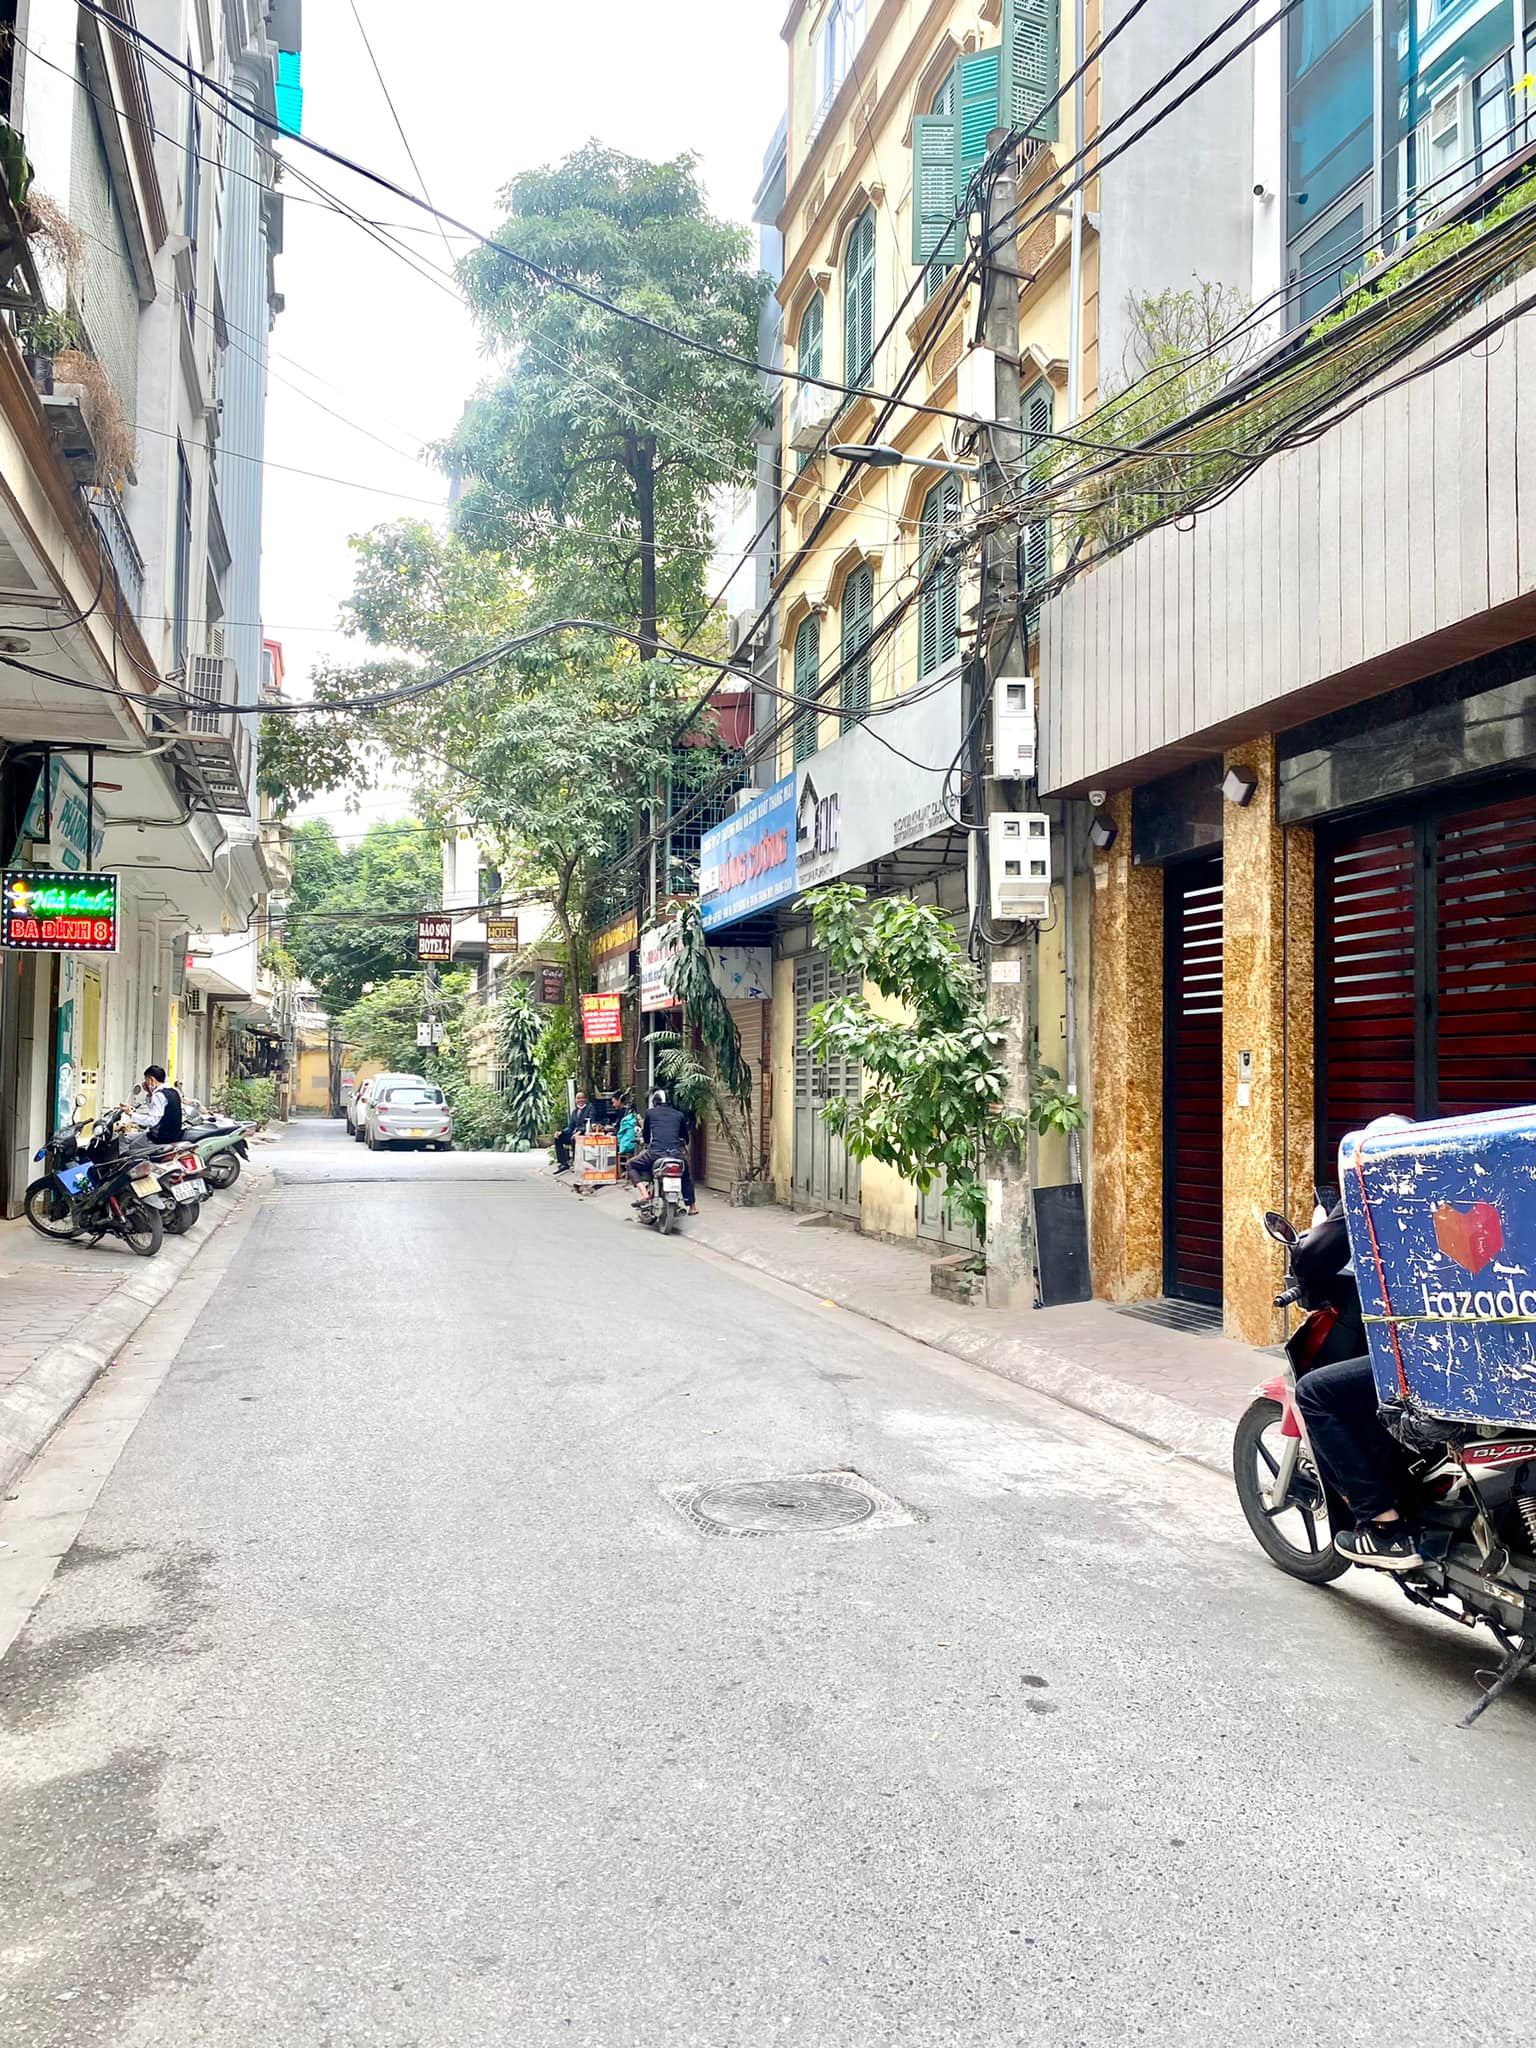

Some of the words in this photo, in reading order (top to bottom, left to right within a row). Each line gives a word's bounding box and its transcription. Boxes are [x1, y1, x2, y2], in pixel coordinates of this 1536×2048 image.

[11, 919, 39, 939] BA
[94, 921, 108, 941] 8
[487, 927, 517, 938] HOTEL
[418, 938, 444, 953] HOTEL
[1472, 1445, 1536, 1459] BLAD
